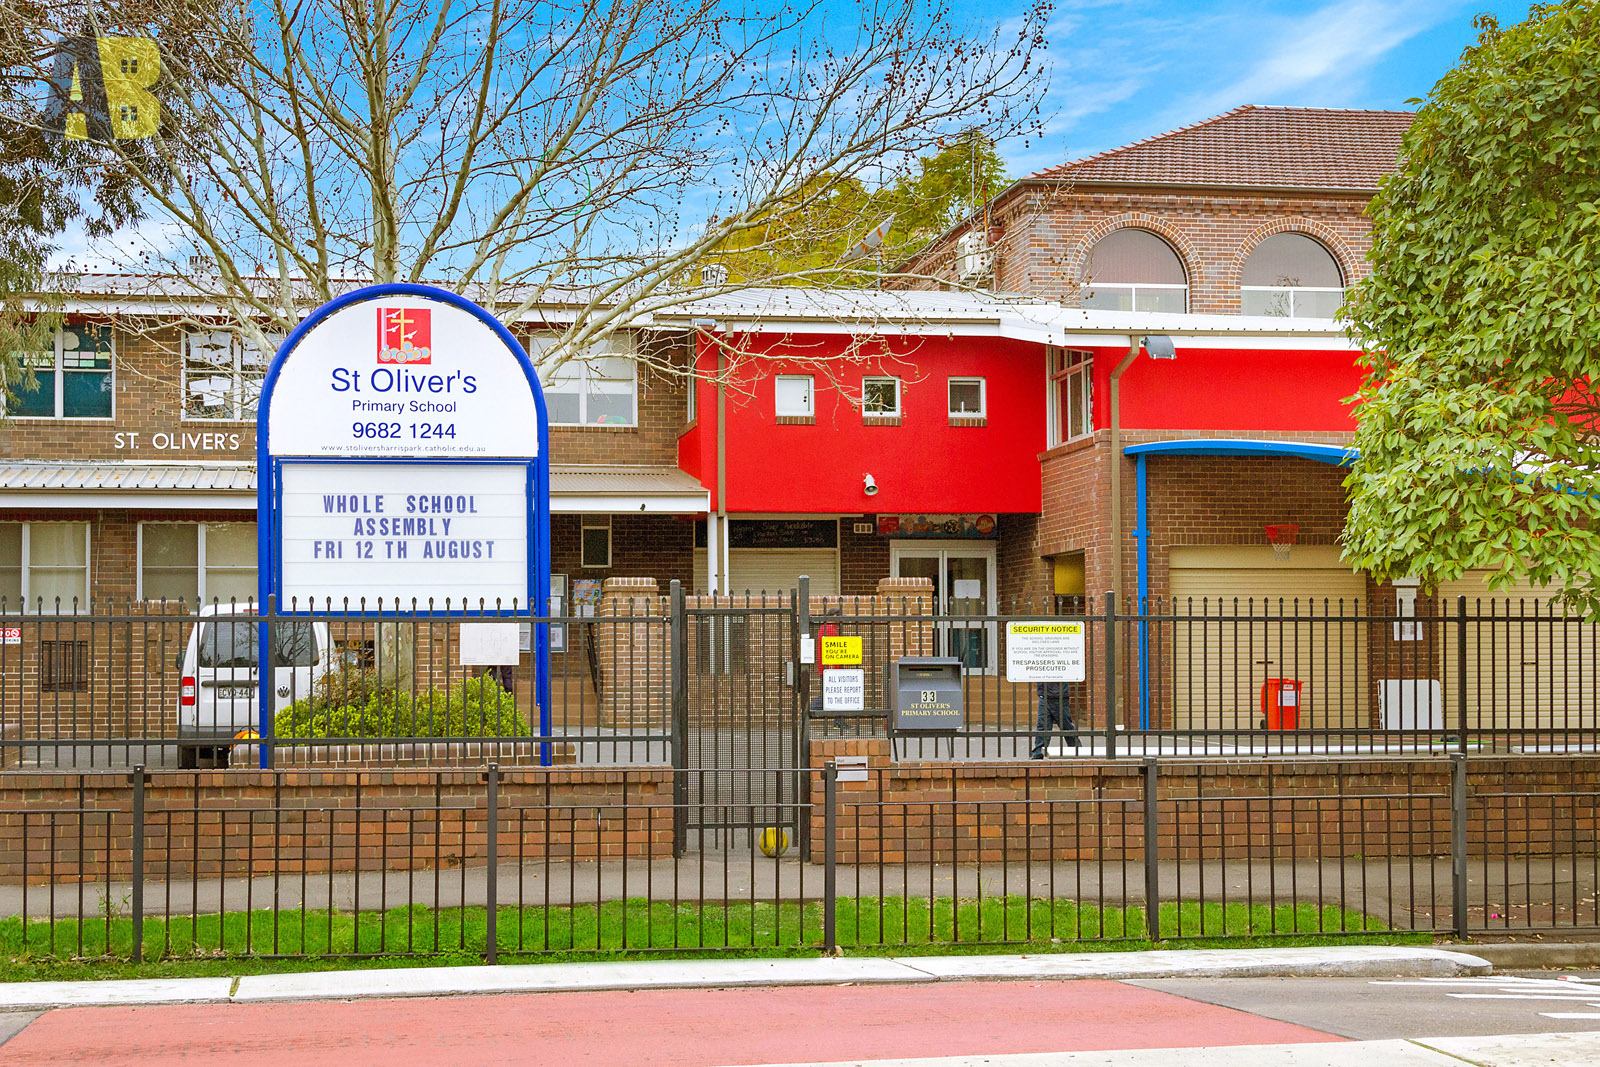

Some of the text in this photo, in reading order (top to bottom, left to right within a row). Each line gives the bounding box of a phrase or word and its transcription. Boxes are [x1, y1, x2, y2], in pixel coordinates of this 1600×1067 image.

[331, 367, 477, 394] St Oliver's
[352, 400, 457, 415] Primary School
[352, 422, 457, 439] 9682 1244
[114, 432, 140, 449] ST.
[152, 432, 240, 451] OLIVER'S
[320, 444, 486, 453] www.stoliversharrispark.catholic.edu.au
[323, 495, 478, 513] WHOLE SCHOOL
[353, 518, 451, 536] ASSEMBLY
[314, 541, 495, 559] FRI 12 TH AUGUST
